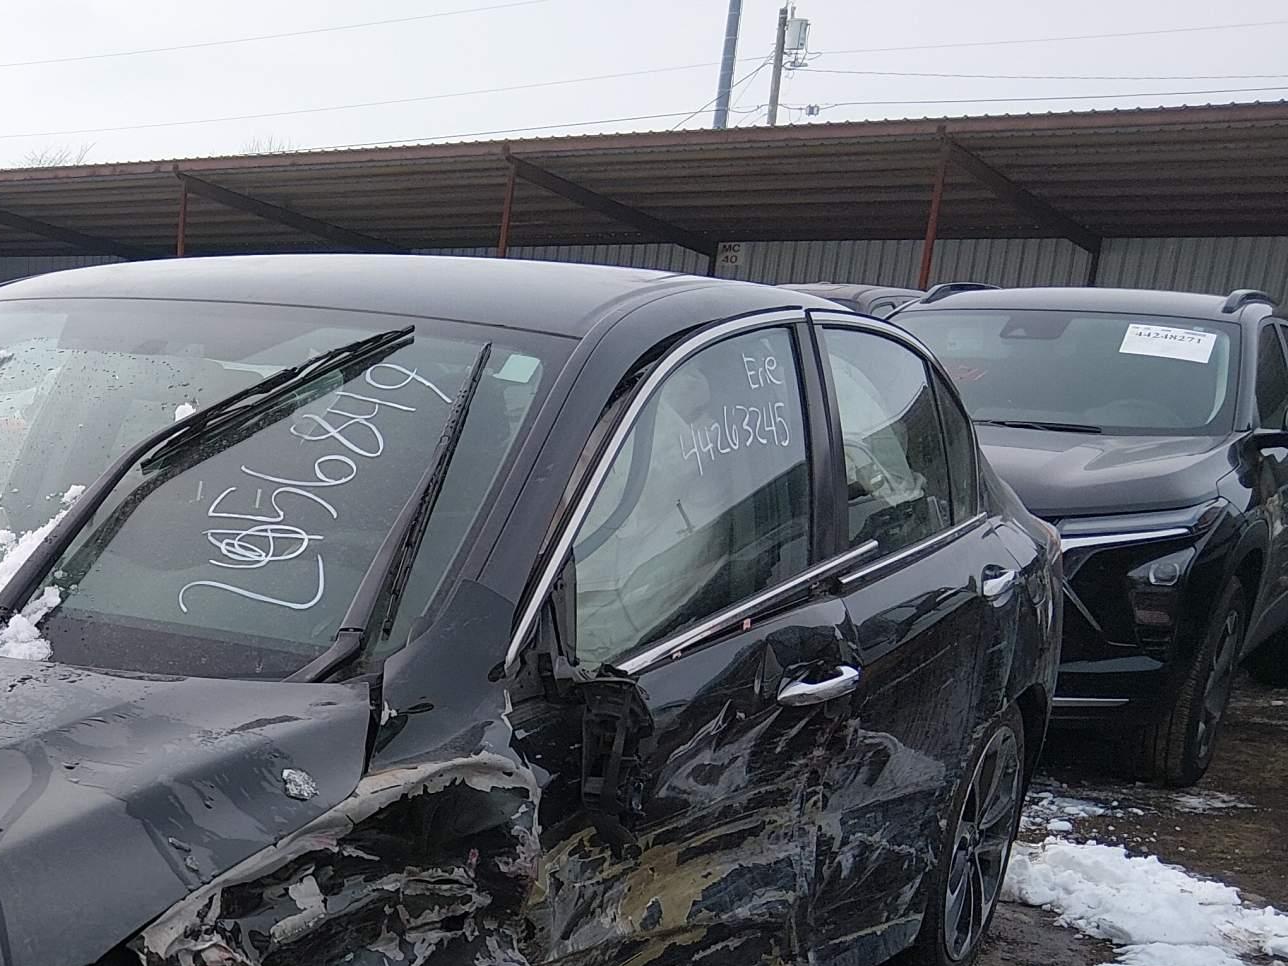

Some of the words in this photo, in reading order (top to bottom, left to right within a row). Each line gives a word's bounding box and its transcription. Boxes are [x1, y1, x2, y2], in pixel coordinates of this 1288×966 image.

[721, 254, 738, 264] 40
[742, 353, 783, 389] Erie
[679, 402, 790, 477] 44263245
